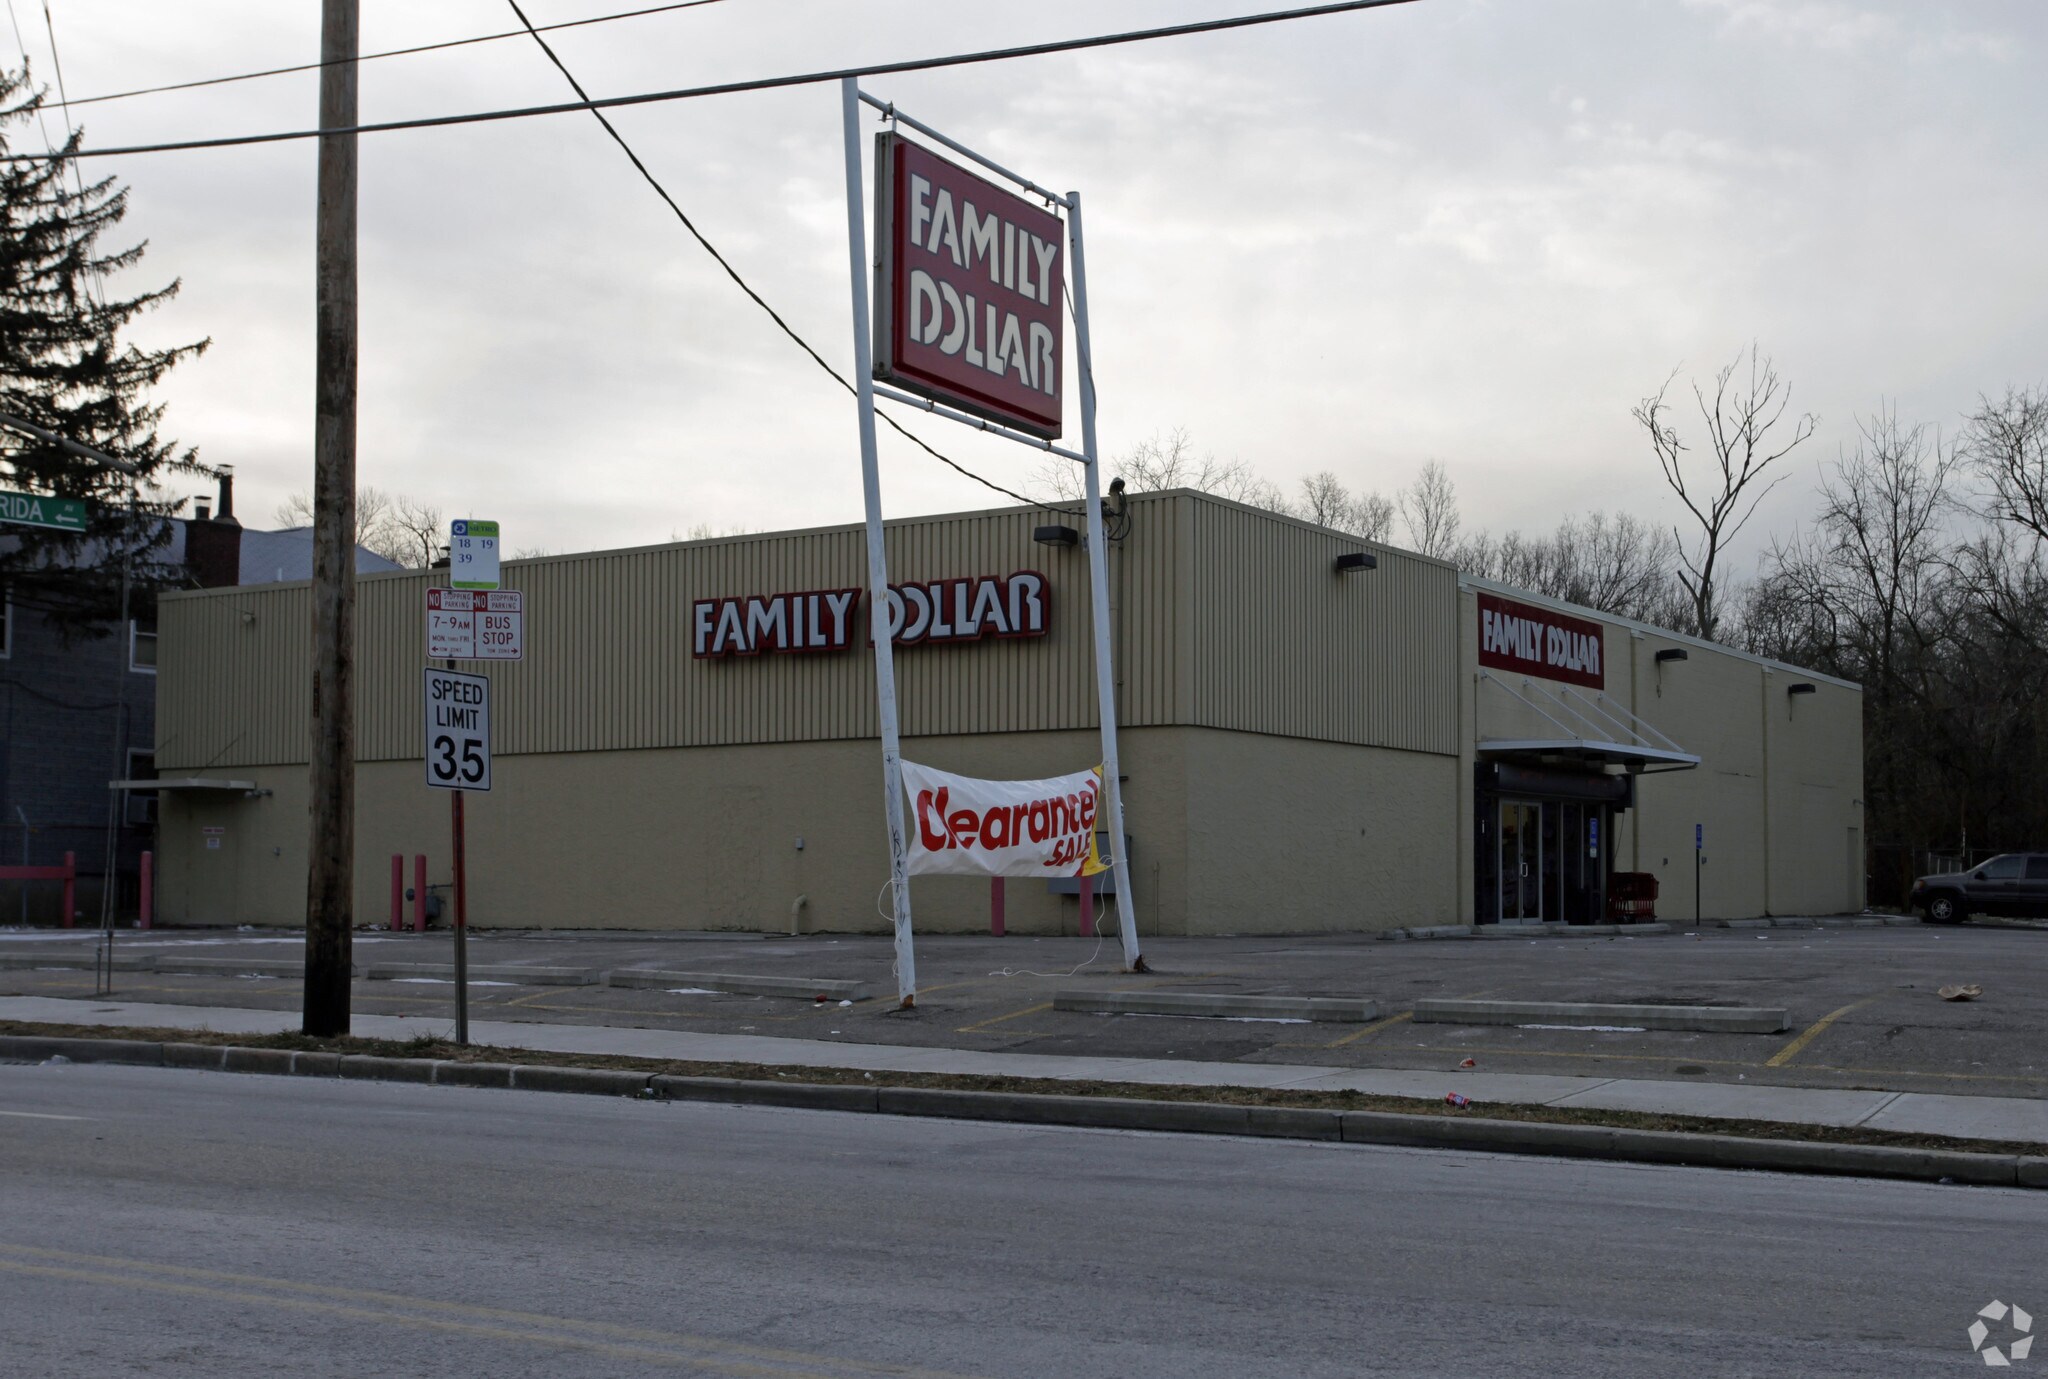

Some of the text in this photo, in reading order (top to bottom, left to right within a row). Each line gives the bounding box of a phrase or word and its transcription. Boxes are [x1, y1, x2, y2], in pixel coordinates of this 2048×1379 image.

[911, 173, 1057, 306] FAMILY
[910, 269, 1054, 395] DOLLAR
[458, 538, 493, 549] 18 19
[458, 553, 472, 563] 39
[429, 593, 440, 607] NO
[443, 592, 471, 600] STOPPING
[475, 595, 486, 608] NO
[490, 594, 518, 602] STOPPING
[444, 600, 470, 609] PARKING
[491, 602, 517, 610] PARKING
[485, 616, 511, 629] BUS
[694, 592, 853, 655] FAMILY
[483, 632, 514, 645] STOP
[1482, 609, 1600, 675] FAMILY DOLLAR
[432, 678, 483, 705] SPEED
[436, 705, 479, 730] LIMIT
[433, 735, 485, 783] 35
[1043, 831, 1091, 867] SALE
